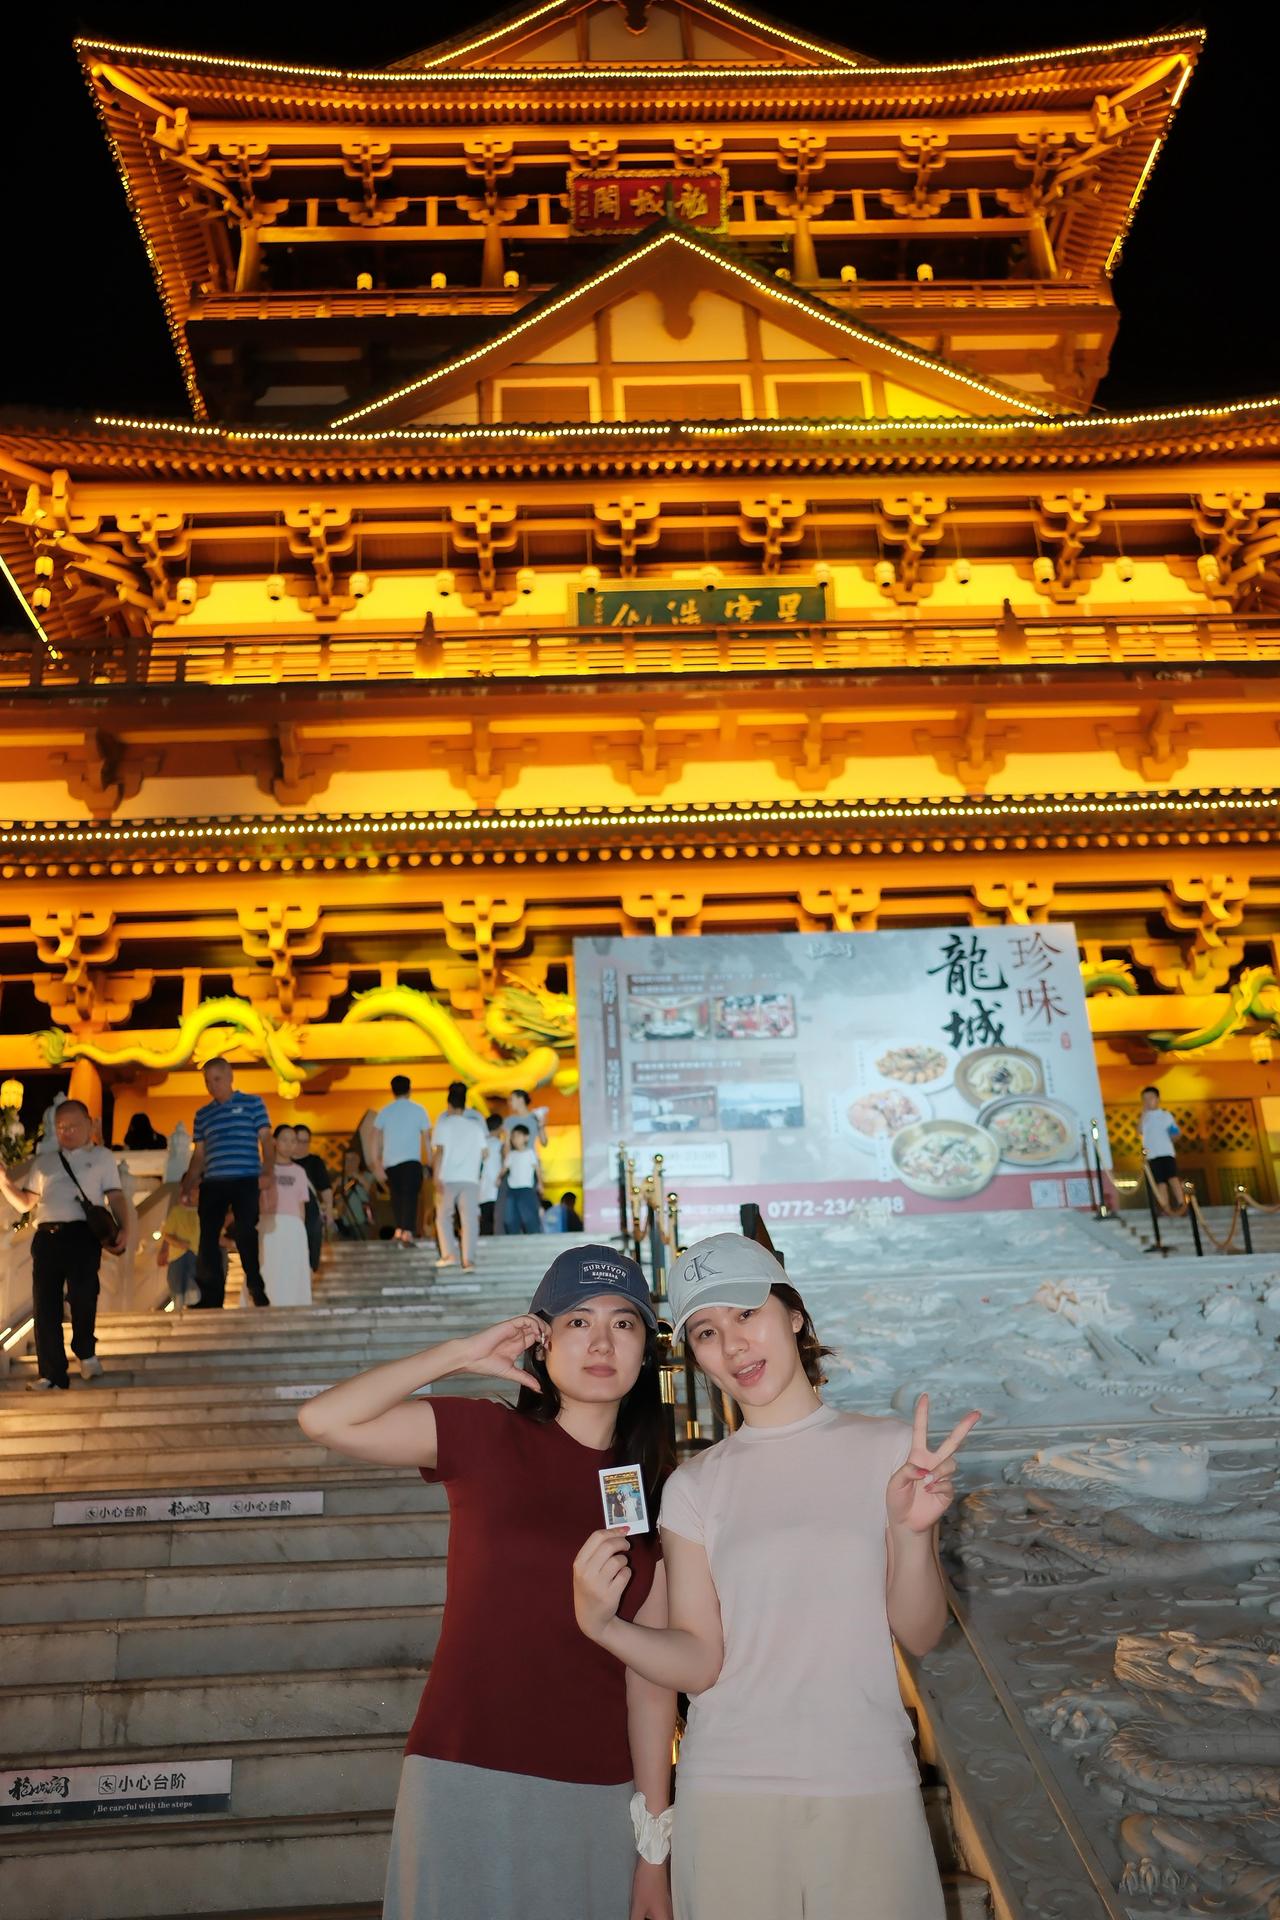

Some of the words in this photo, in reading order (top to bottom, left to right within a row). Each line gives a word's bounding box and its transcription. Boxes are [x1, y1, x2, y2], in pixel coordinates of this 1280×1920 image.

[1008, 931, 1070, 1027] 珍味
[583, 1264, 627, 1279] SURVIVOR
[99, 1505, 147, 1519] 小心台阶
[244, 1500, 292, 1513] 小心台阶
[118, 1773, 187, 1792] 小心台阶
[97, 1804, 108, 1813] Be
[109, 1803, 137, 1812] careful
[138, 1801, 156, 1810] with
[157, 1801, 170, 1809] the
[171, 1800, 193, 1810] steps
